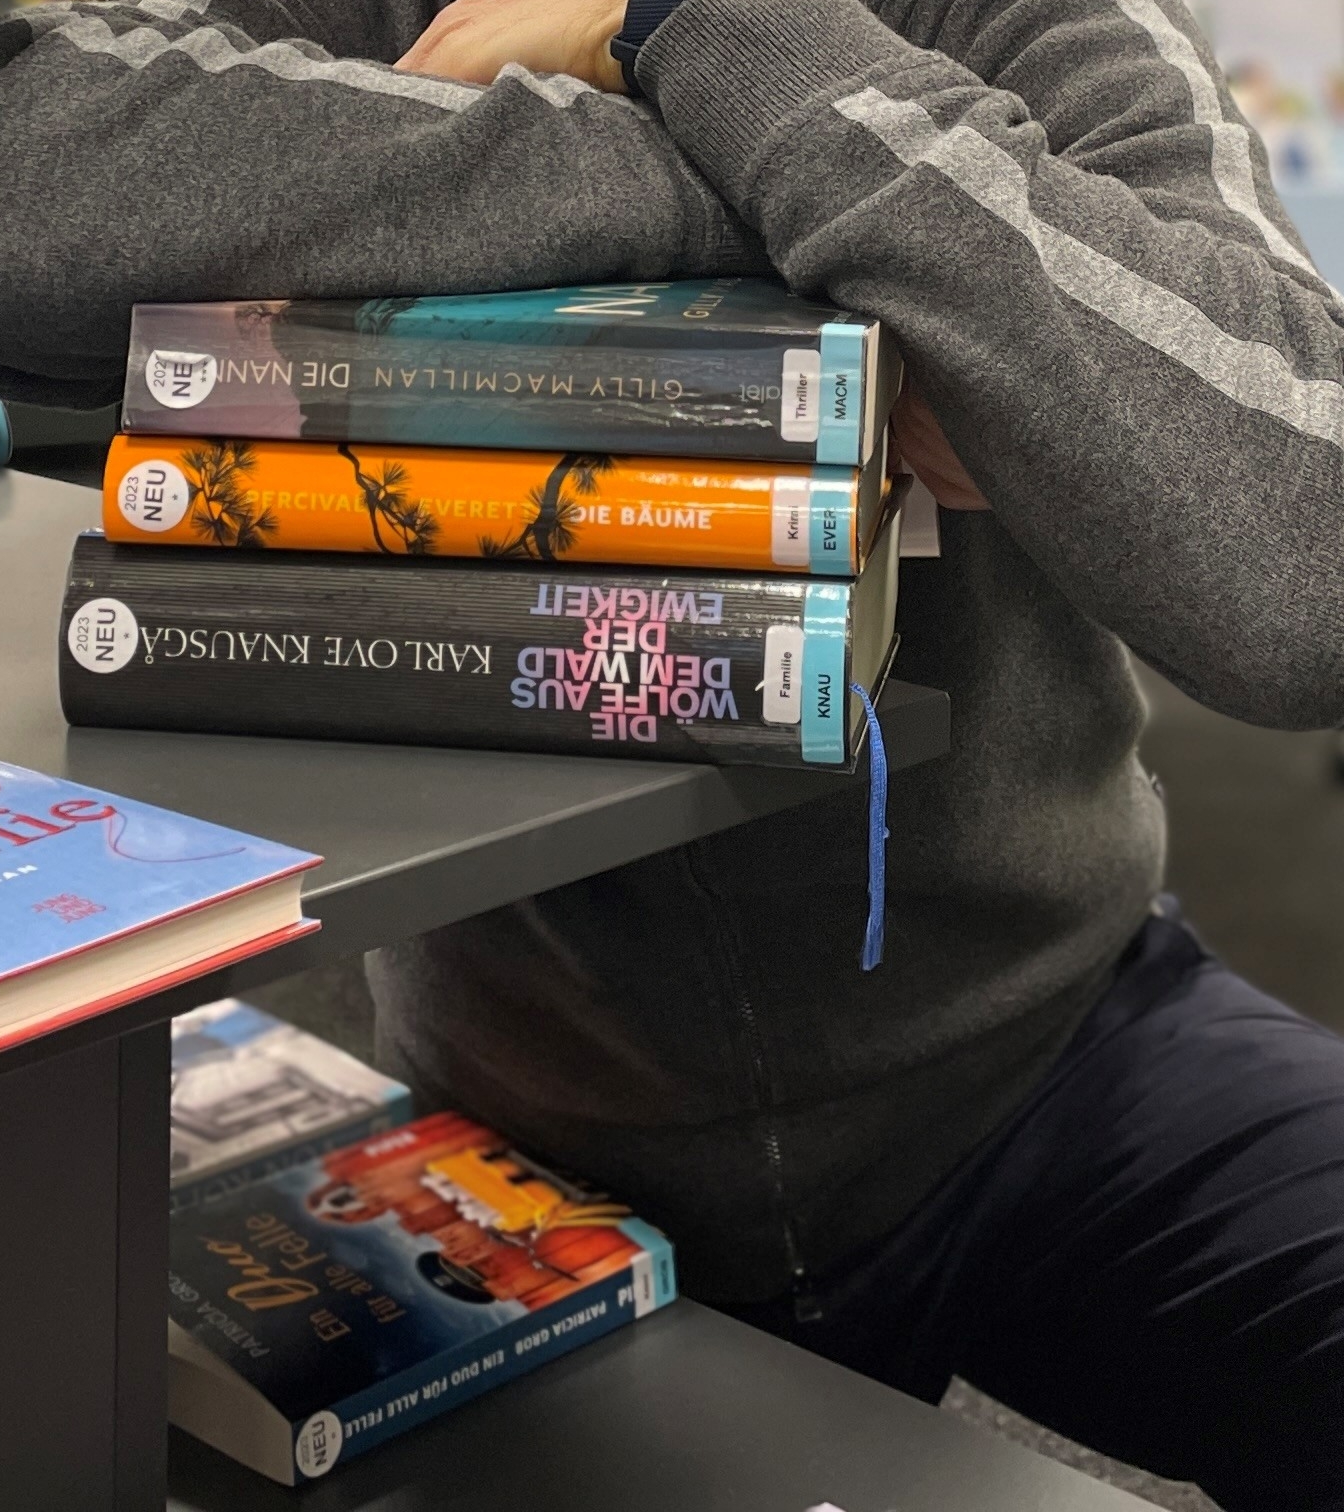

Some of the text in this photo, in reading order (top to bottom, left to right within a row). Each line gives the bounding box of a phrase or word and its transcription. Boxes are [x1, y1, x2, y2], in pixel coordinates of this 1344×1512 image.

[301, 362, 351, 388] DIE
[375, 366, 573, 394] MACMILLAN
[589, 377, 683, 400] GILLY
[795, 373, 808, 419] Thriller
[834, 374, 848, 420] MACM
[124, 476, 139, 511] 2023
[143, 469, 167, 522] NEU
[570, 504, 611, 525] DIE
[823, 508, 837, 551] EVER
[529, 583, 725, 625] EWIGKEIT
[76, 616, 90, 652] 2023
[96, 607, 117, 662] NEU
[140, 626, 493, 675] KARL OVE KNAUSGÅ
[583, 619, 668, 654] DER
[517, 647, 731, 689] DEM WALD
[779, 651, 792, 699] Familie
[510, 677, 740, 725] WÖLFE AUS
[817, 674, 832, 720] KNAU
[590, 712, 657, 743] DIE
[246, 1213, 406, 1323] für alle Felle
[206, 1239, 351, 1342] Ein Duo
[552, 1301, 606, 1337] PATRICIA
[482, 1349, 505, 1372] EIN
[514, 1329, 550, 1356] GROB
[423, 1376, 447, 1401] FÜR
[451, 1363, 481, 1387] DUO
[387, 1391, 419, 1419] ALLE
[345, 1409, 383, 1439] FELLE
[312, 1420, 328, 1467] NEU
